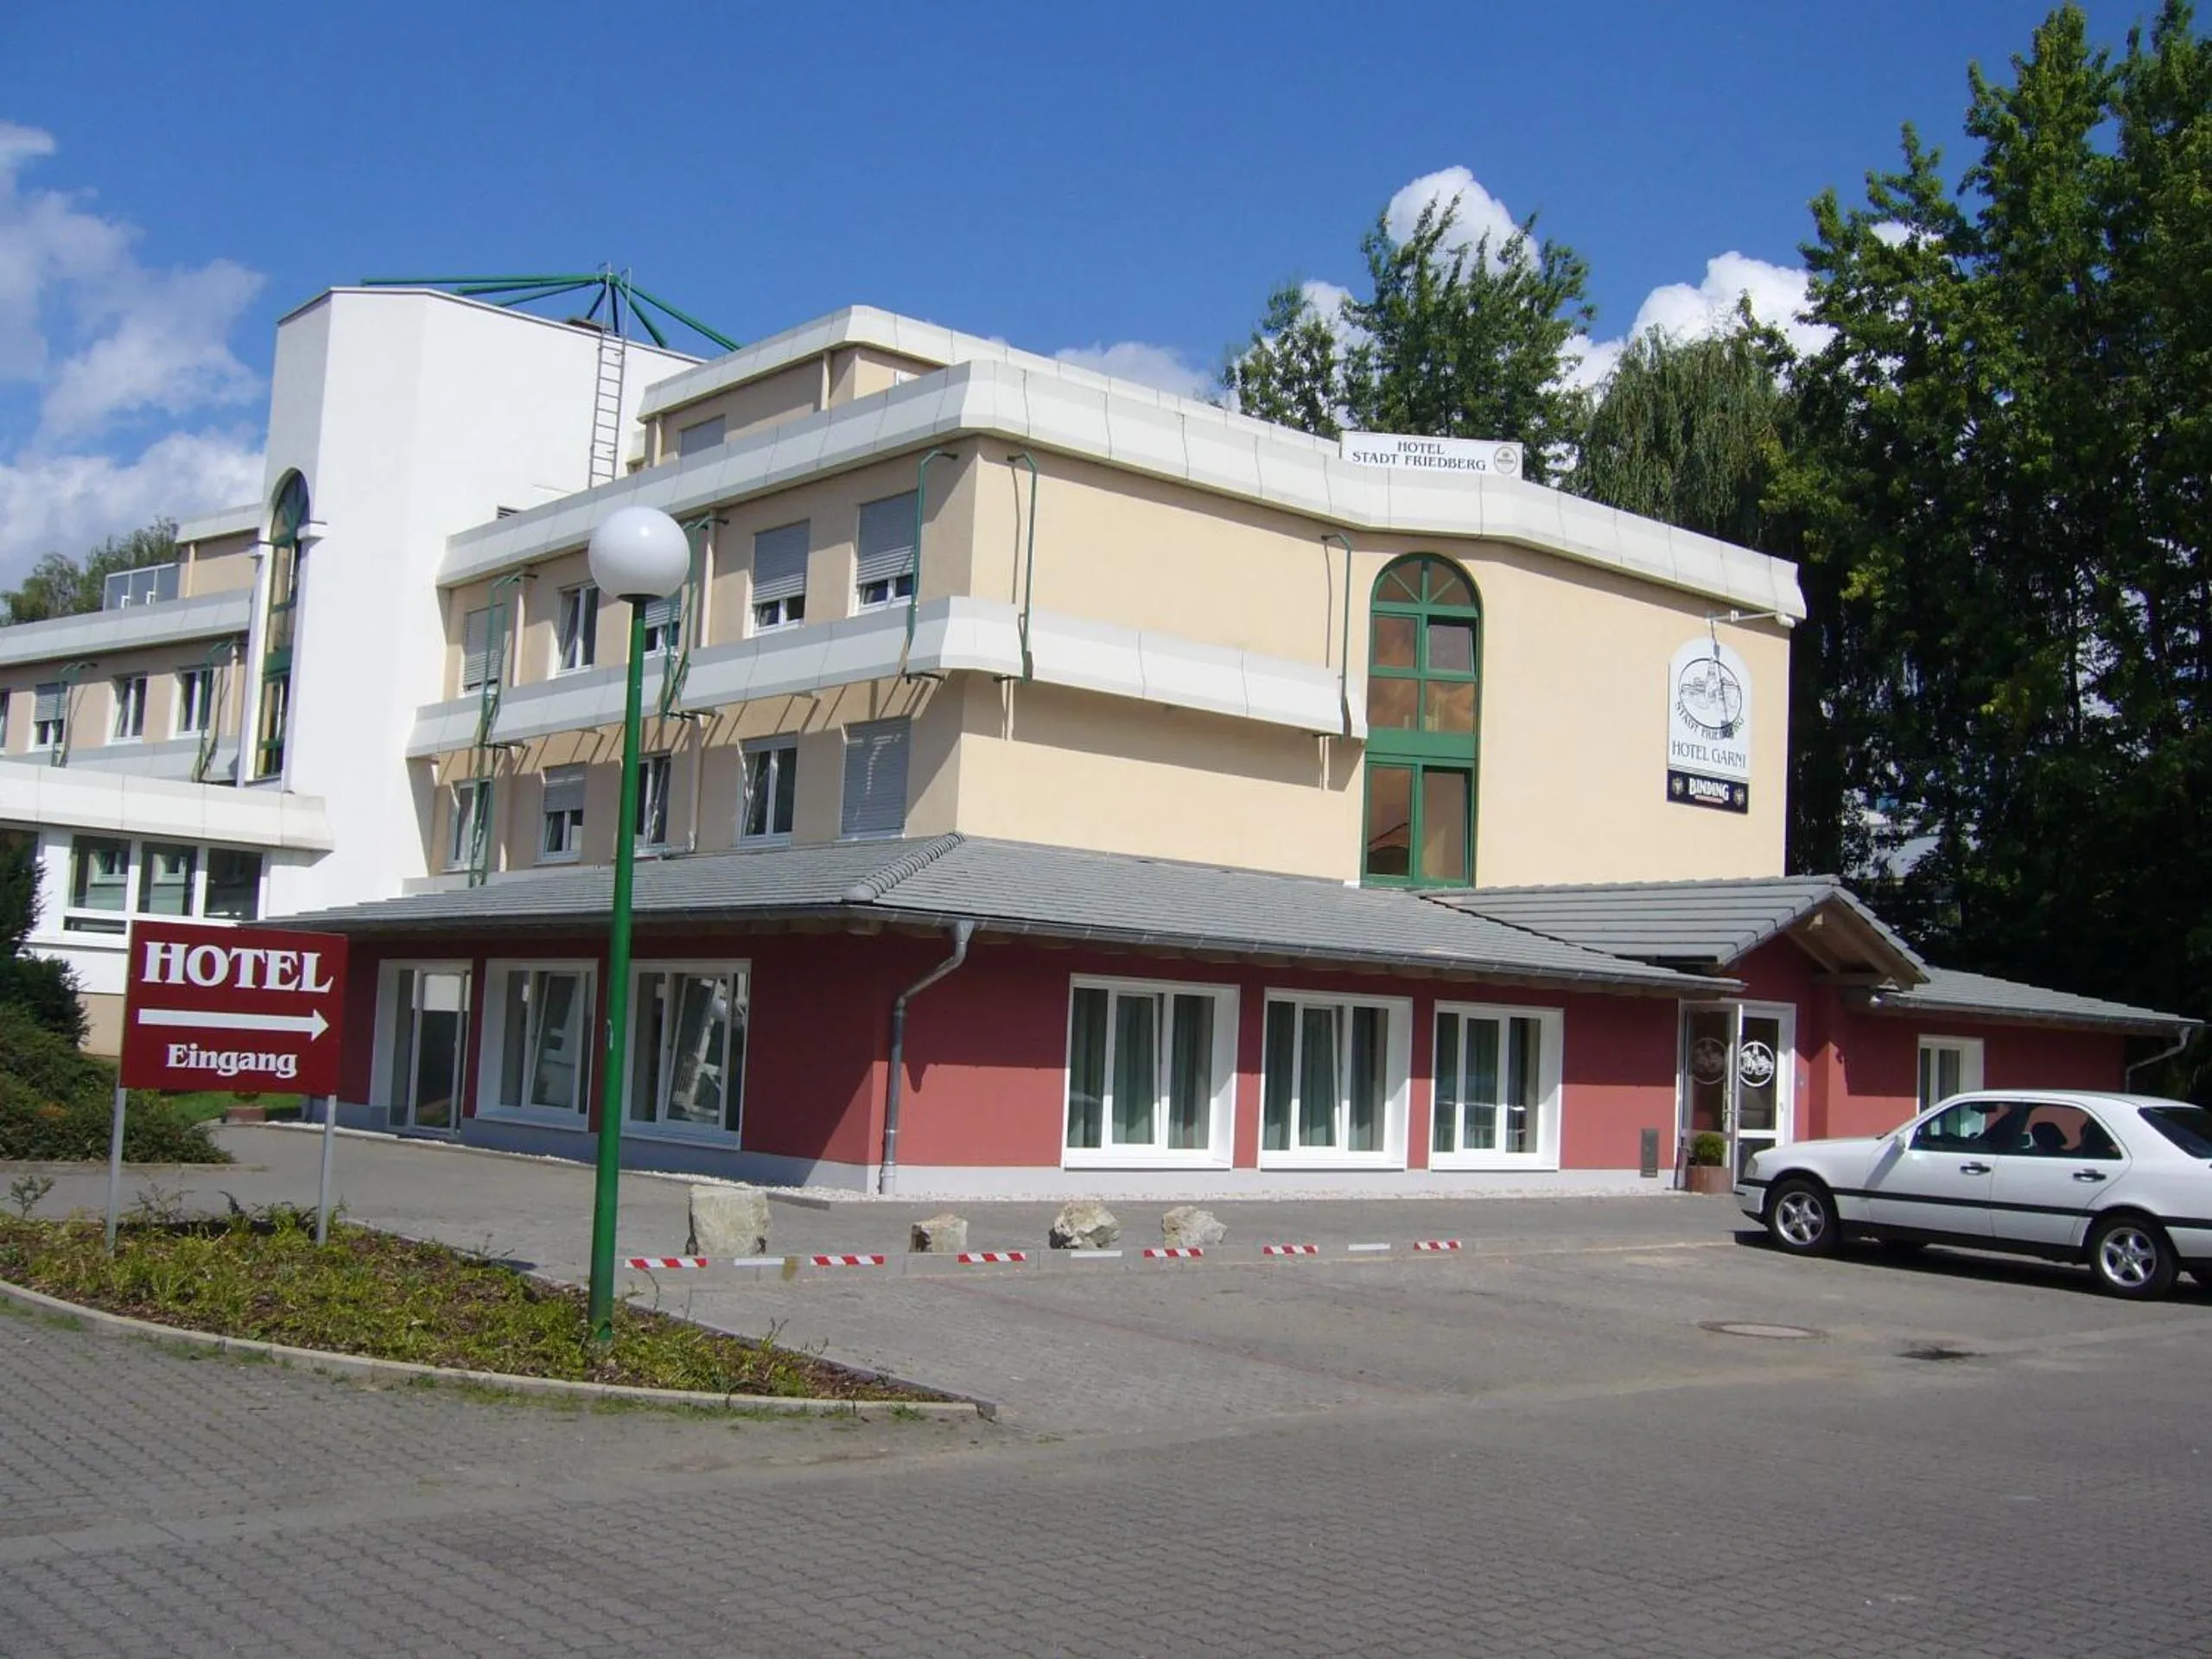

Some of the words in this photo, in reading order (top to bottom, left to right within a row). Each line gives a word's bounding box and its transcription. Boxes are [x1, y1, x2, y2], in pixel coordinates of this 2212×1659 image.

[1352, 451, 1398, 465] STADT
[1404, 454, 1486, 471] FRIEDBERG
[1397, 440, 1445, 455] HOTEL
[1675, 701, 1699, 733] STADT
[1671, 741, 1710, 762] HOTEL
[1712, 747, 1746, 768] GARNI
[1688, 778, 1729, 802] BINDING
[141, 941, 334, 994] HOTEL
[166, 1042, 298, 1079] Eingang
